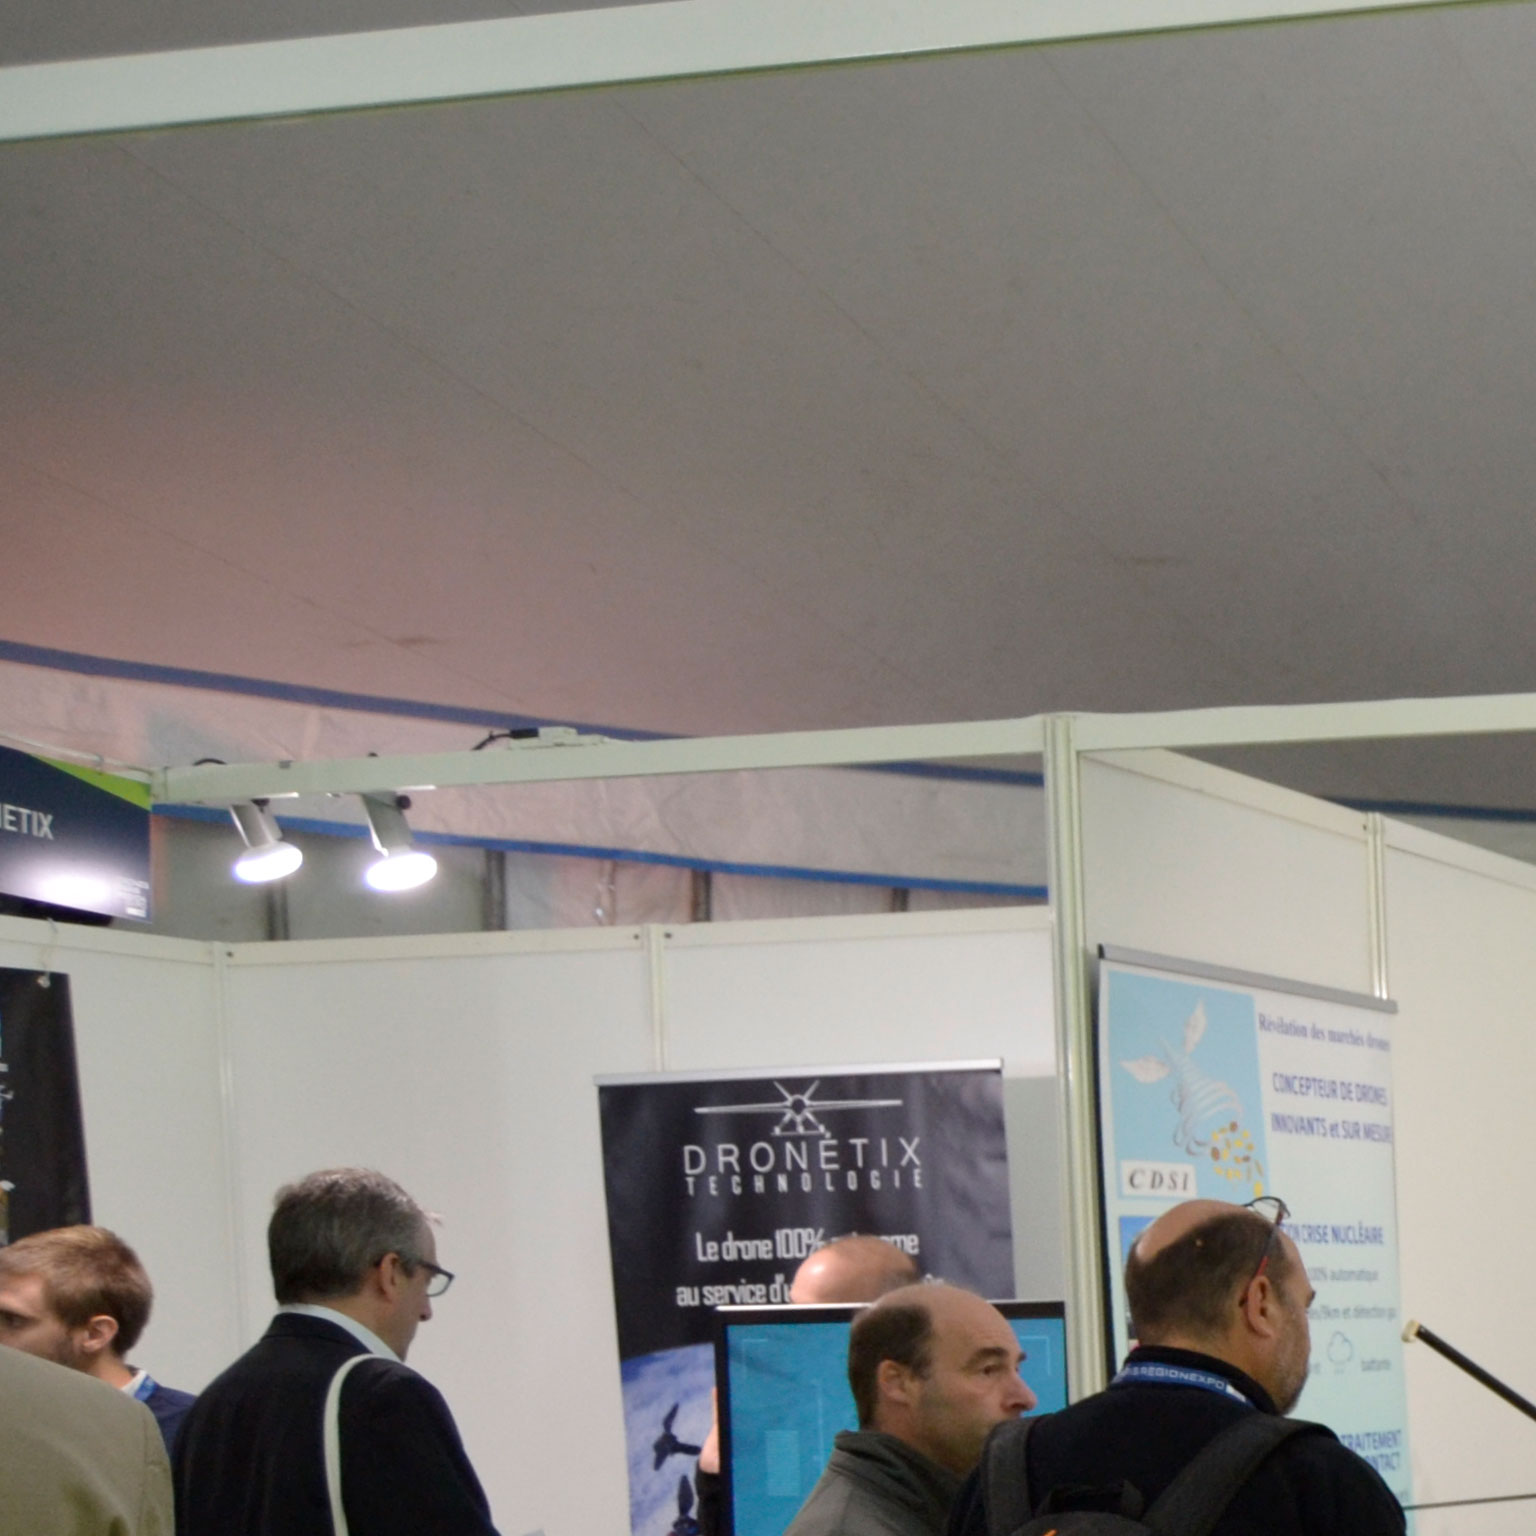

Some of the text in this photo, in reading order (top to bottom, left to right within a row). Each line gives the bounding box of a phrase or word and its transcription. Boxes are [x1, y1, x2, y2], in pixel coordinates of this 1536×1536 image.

[0, 803, 54, 840] ETIX
[1272, 1072, 1338, 1098] CONCEPTEUR
[1340, 1081, 1353, 1101] DE
[1342, 1120, 1361, 1140] SUR
[684, 1169, 923, 1196] TECHNOLOGIE
[1129, 1168, 1189, 1192] CDSI
[696, 1231, 718, 1262] Le
[722, 1231, 772, 1261] drone
[775, 1228, 825, 1259] 100%
[676, 1286, 699, 1307] au
[703, 1279, 767, 1306] service
